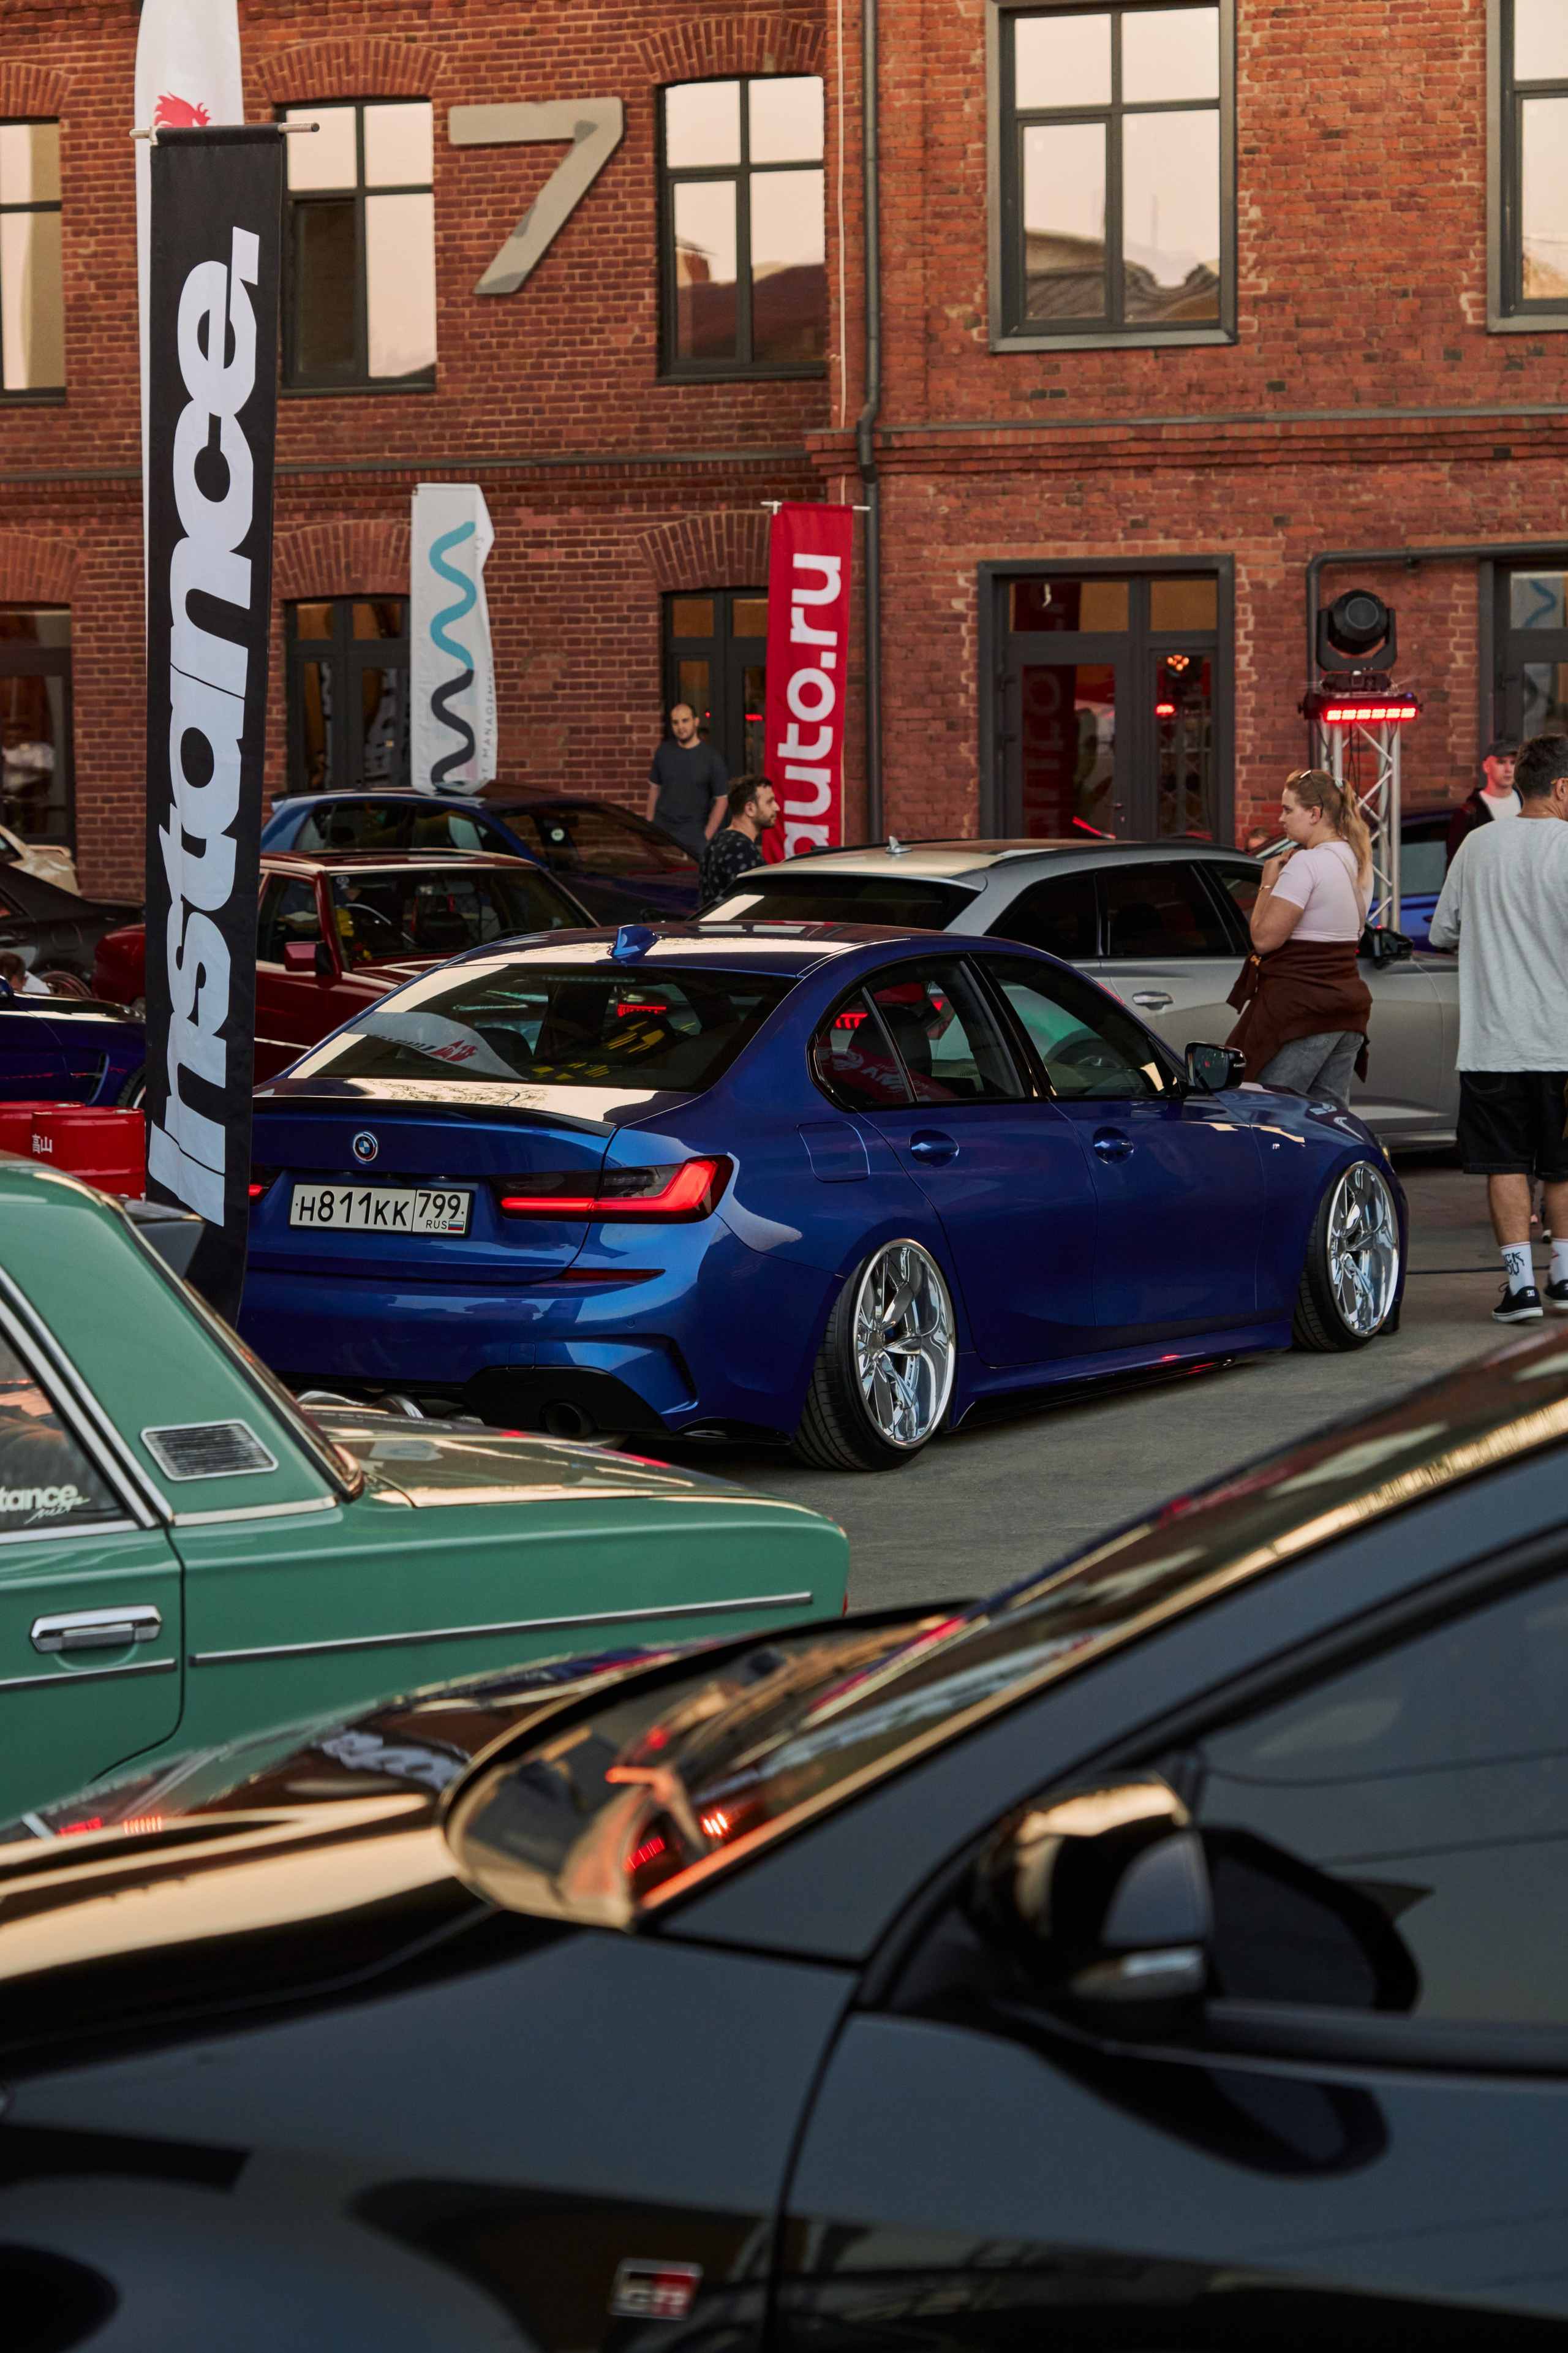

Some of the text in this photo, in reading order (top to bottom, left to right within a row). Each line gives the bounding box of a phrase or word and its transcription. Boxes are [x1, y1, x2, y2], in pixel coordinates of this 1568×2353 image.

[448, 96, 624, 295] 7
[418, 1193, 461, 1219] 799
[426, 1220, 447, 1229] RUS
